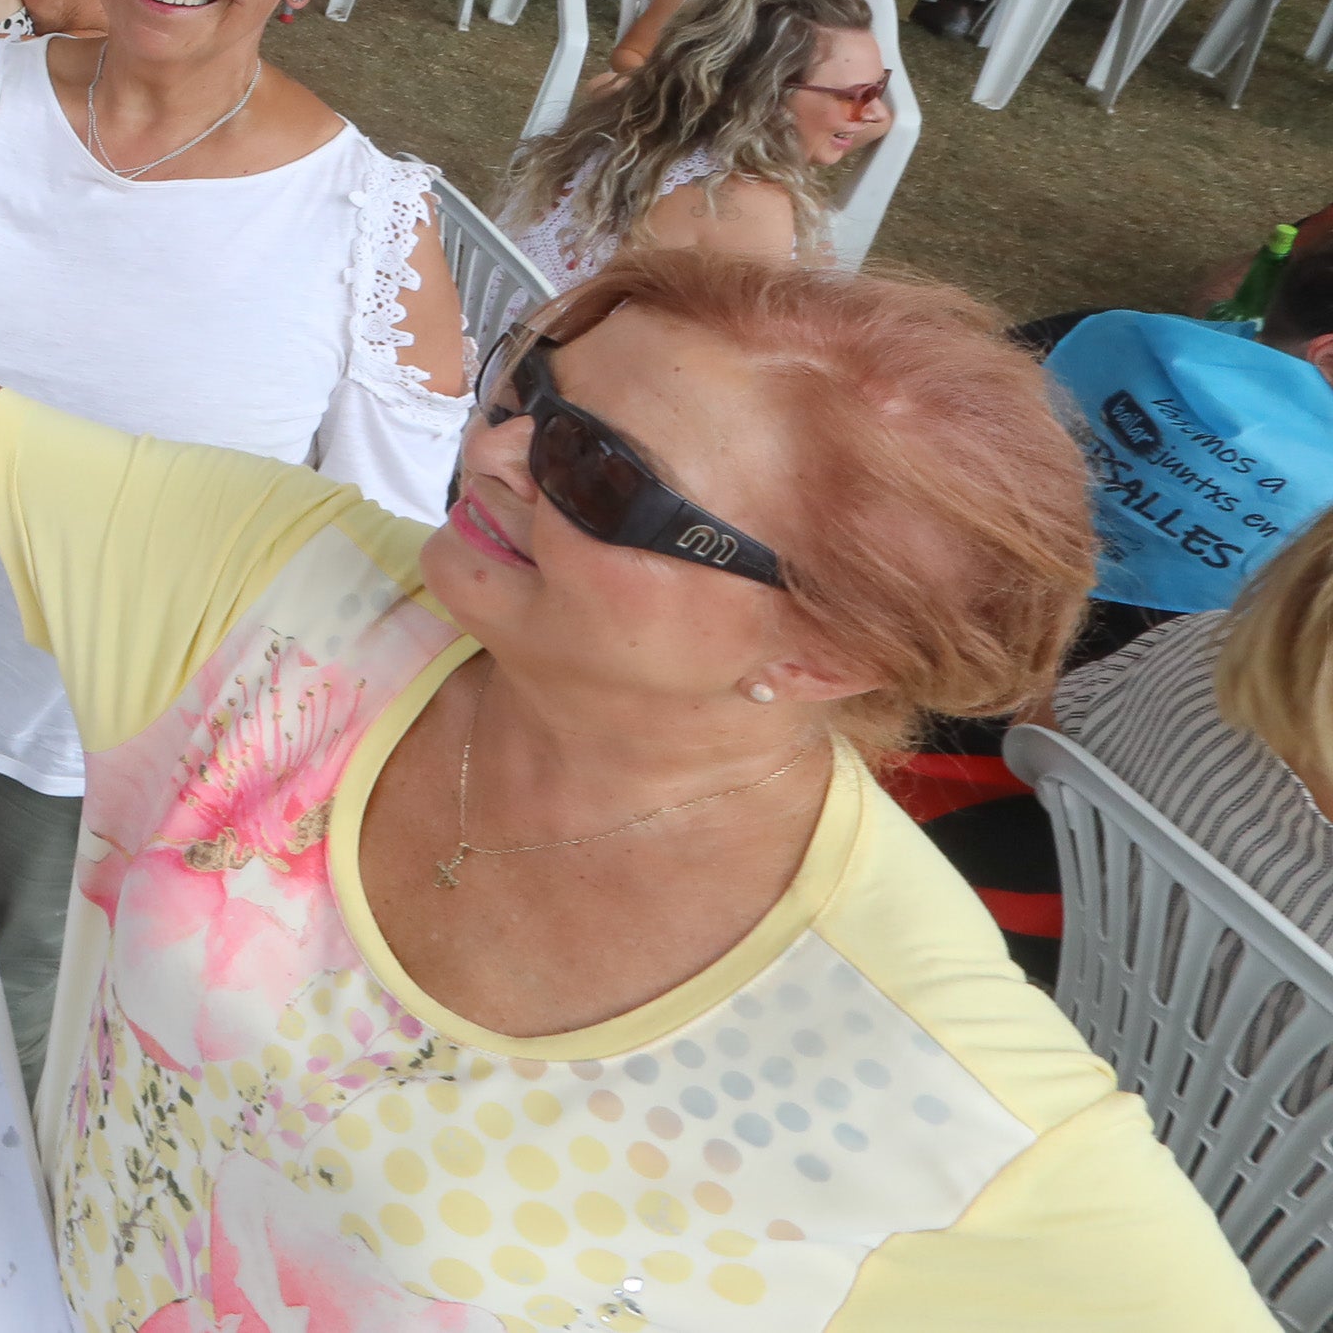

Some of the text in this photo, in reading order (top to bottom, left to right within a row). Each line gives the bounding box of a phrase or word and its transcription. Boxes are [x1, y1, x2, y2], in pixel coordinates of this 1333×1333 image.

[1147, 445, 1242, 512] juntxs
[1242, 513, 1281, 538] en
[1257, 477, 1288, 494] a
